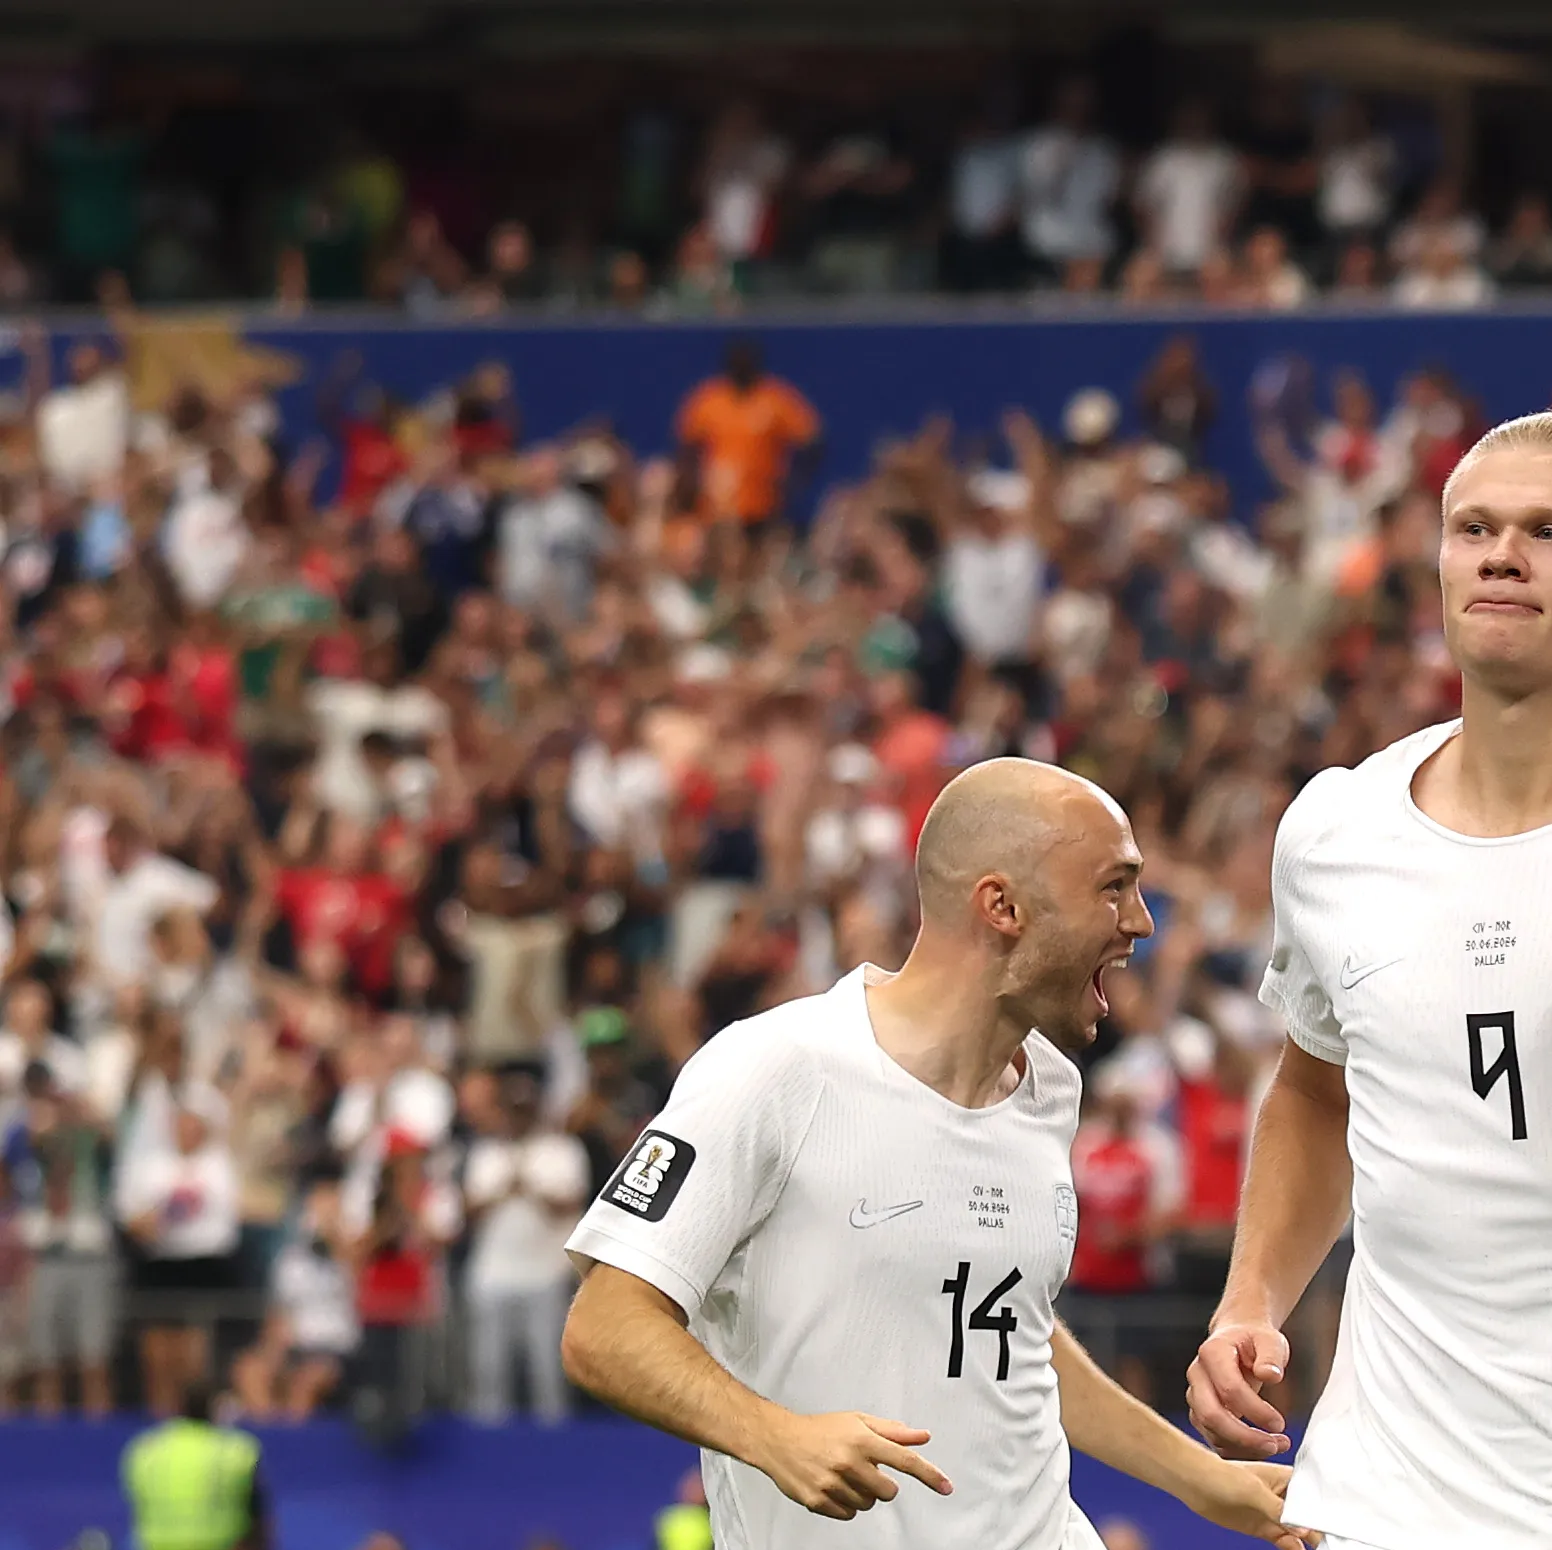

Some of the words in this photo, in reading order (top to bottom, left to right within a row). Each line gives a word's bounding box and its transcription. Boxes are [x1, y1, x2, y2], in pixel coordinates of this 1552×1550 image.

[1474, 953, 1506, 967] DALLAS
[1466, 1010, 1528, 1141] 9
[612, 1189, 650, 1213] 2026
[978, 1216, 1005, 1229] DALLAS
[941, 1261, 1024, 1382] 14
